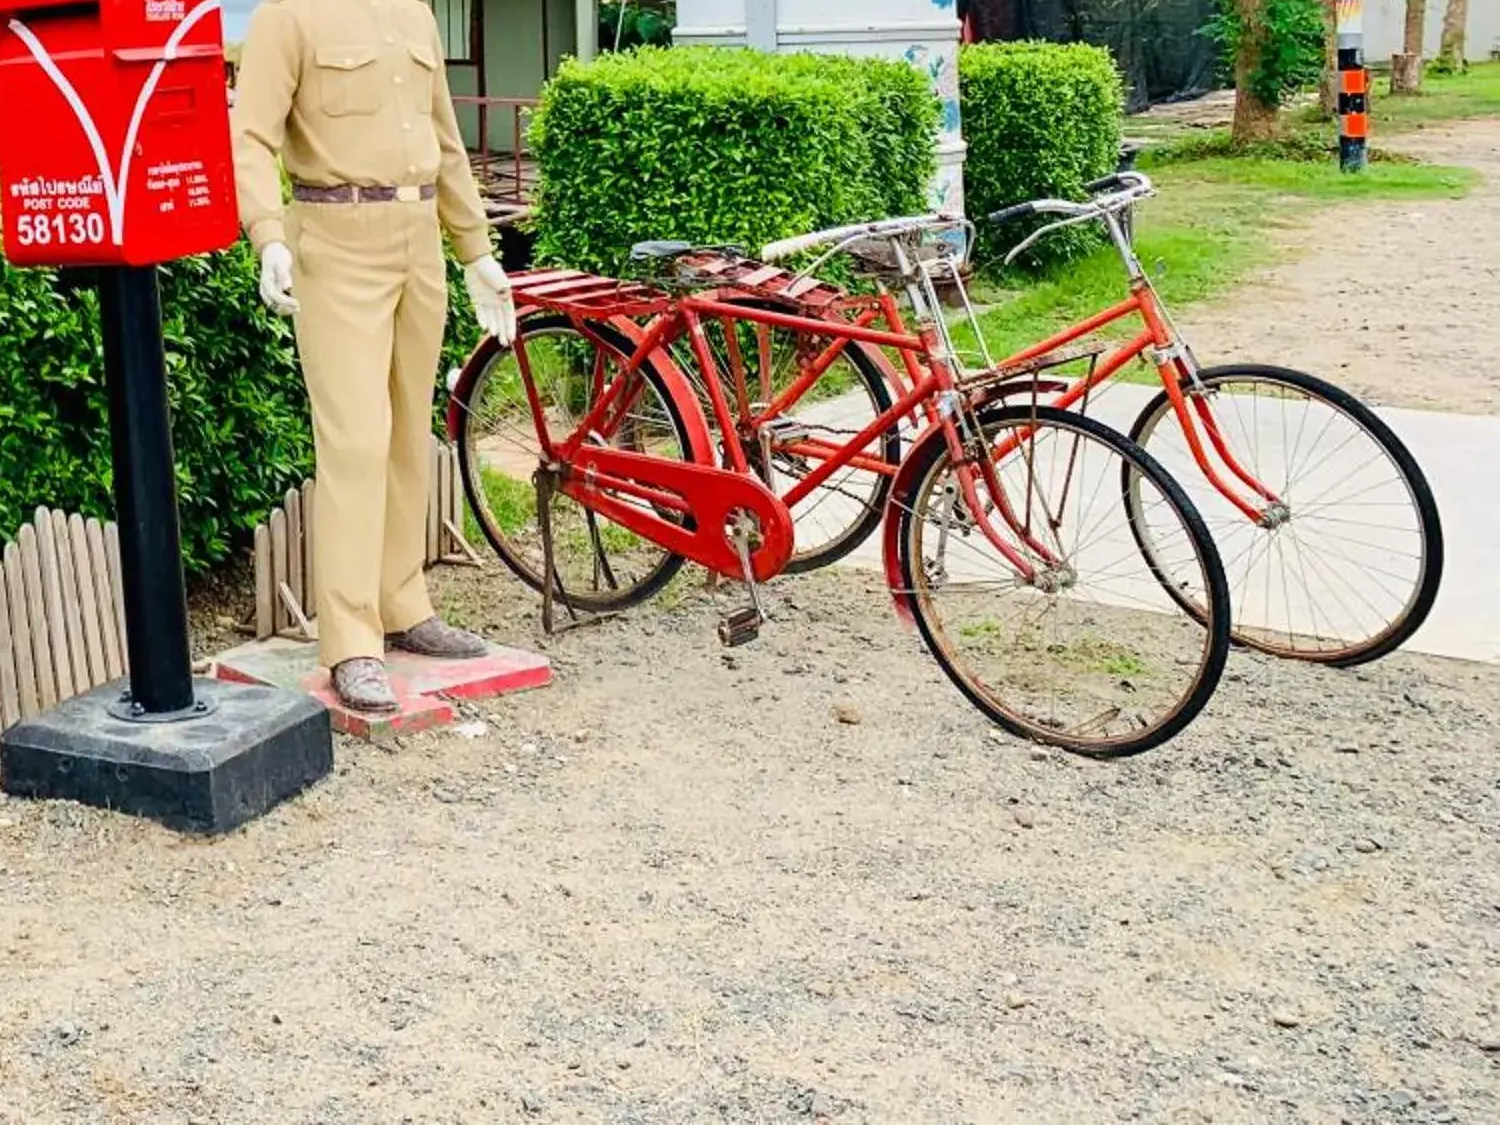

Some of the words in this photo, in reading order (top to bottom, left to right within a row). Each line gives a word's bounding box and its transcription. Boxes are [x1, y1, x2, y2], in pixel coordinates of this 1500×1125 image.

[23, 198, 53, 210] POST
[57, 197, 91, 210] CODE
[17, 212, 105, 245] 58130
